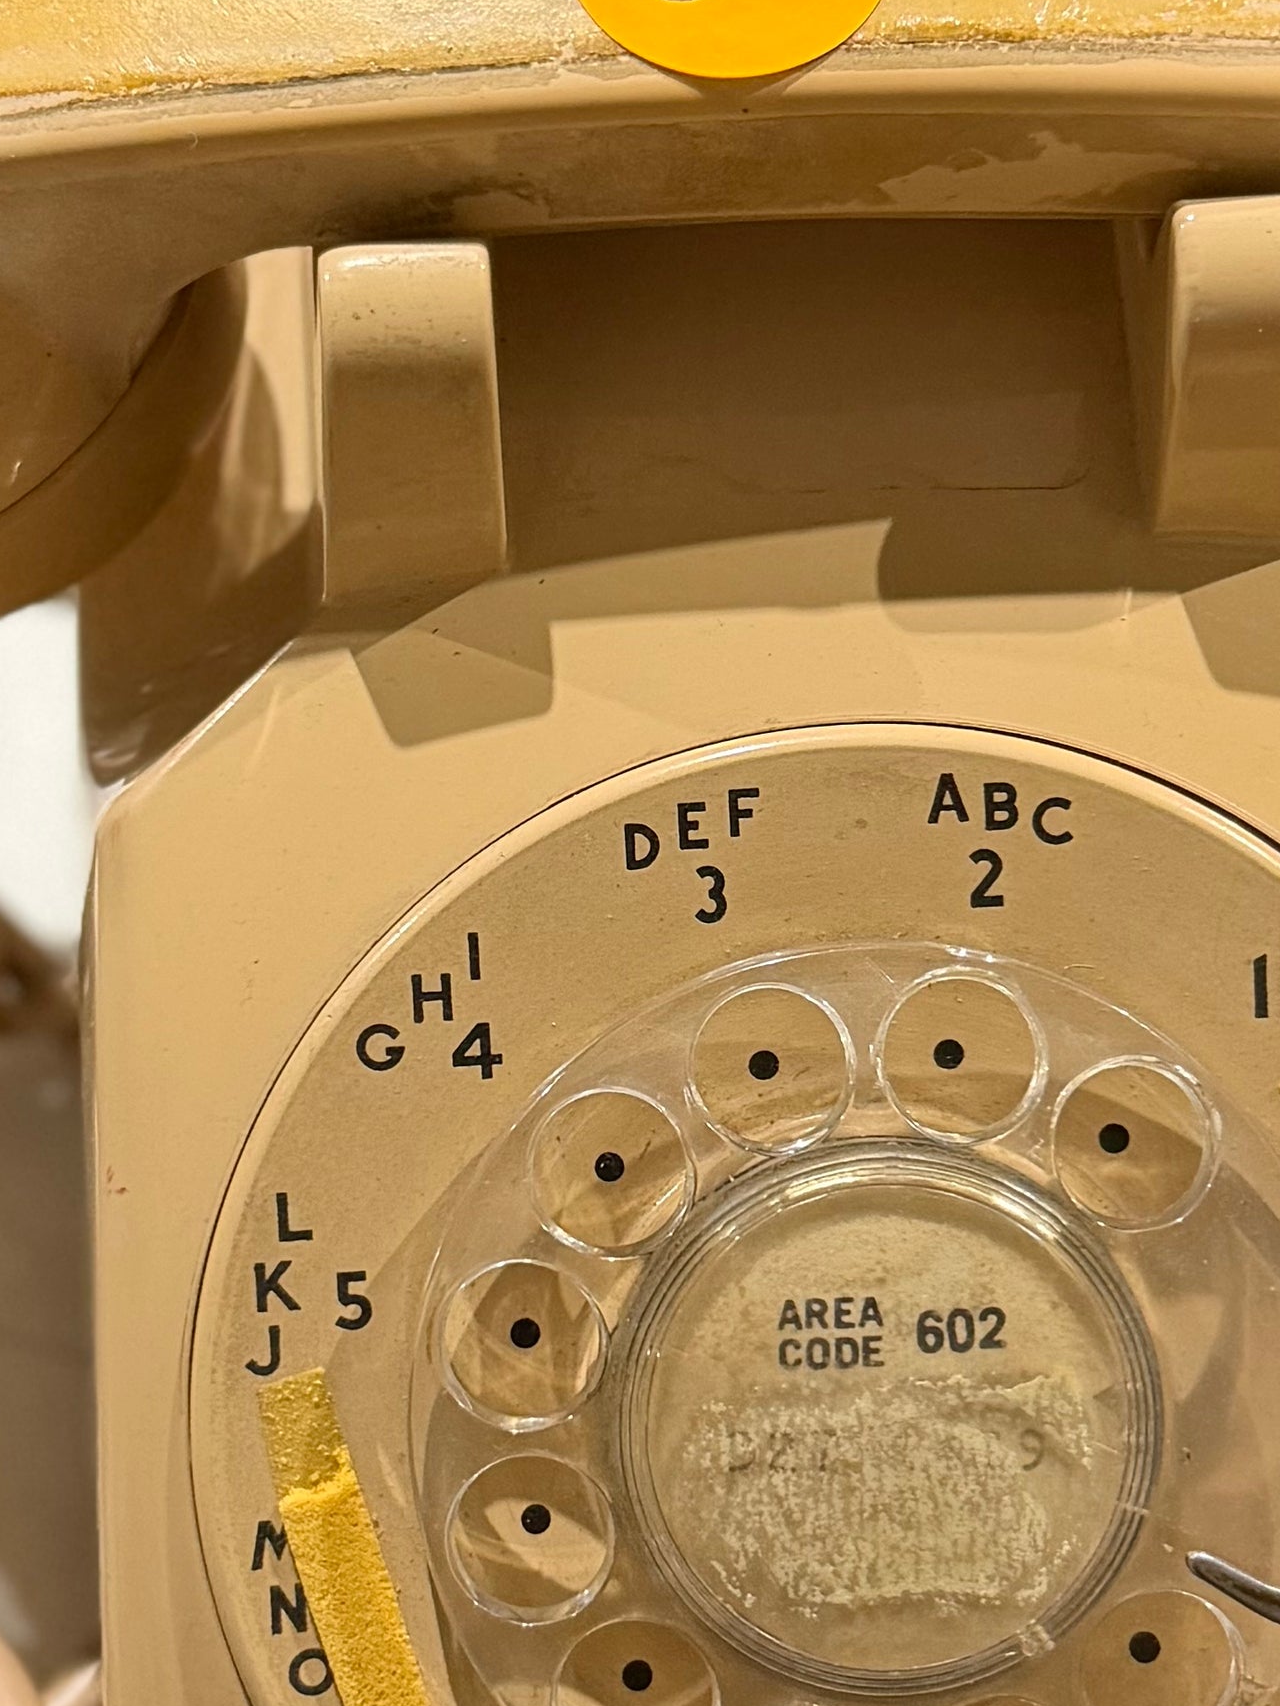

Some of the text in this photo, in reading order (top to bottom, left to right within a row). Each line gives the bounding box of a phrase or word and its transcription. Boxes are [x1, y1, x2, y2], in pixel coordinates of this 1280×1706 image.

[623, 787, 761, 871] DEF
[927, 772, 1074, 845] ABC
[694, 865, 728, 924] 3
[968, 848, 1005, 909] 2
[1251, 953, 1270, 1019] 1
[451, 1022, 504, 1080] 4
[334, 1269, 373, 1331] 5
[777, 1295, 885, 1332] AREA
[777, 1335, 885, 1371] CODE
[915, 1306, 1008, 1355] 602
